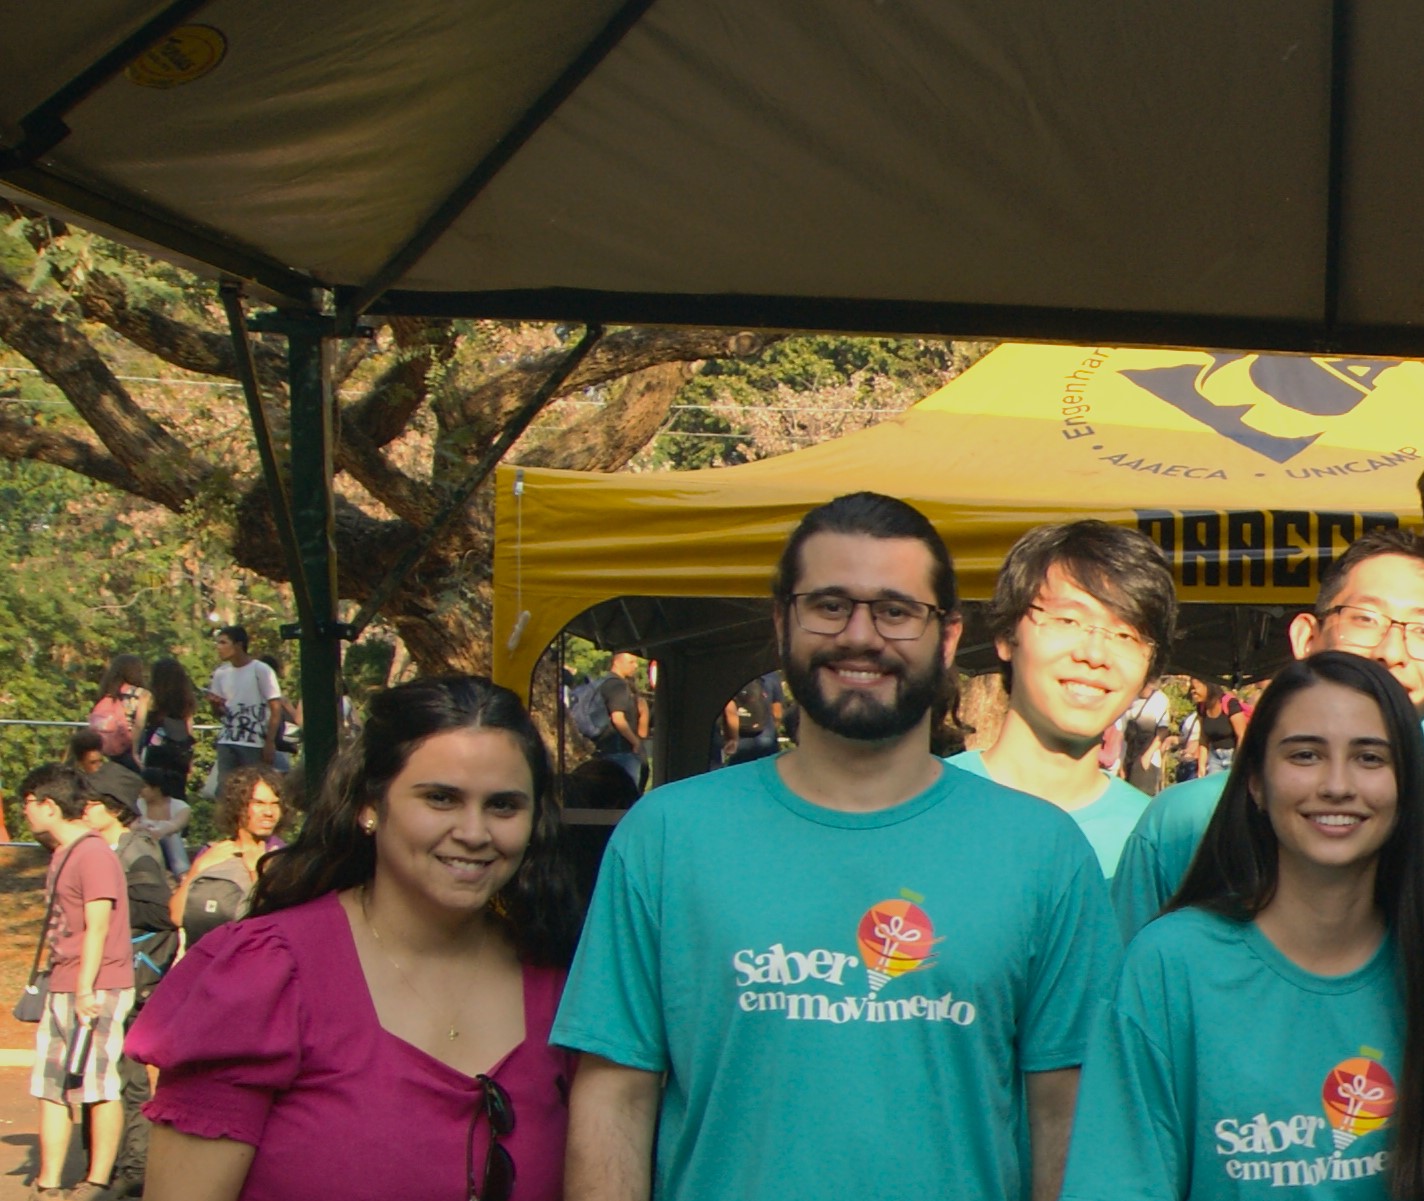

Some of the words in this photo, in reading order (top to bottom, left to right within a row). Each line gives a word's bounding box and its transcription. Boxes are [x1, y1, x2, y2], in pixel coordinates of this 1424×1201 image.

[1062, 349, 1109, 440] Engenhar
[1098, 453, 1227, 480] AAAECA
[1285, 446, 1421, 479] UNICAMP
[733, 943, 859, 987] Saber
[1214, 1112, 1325, 1155] Saber
